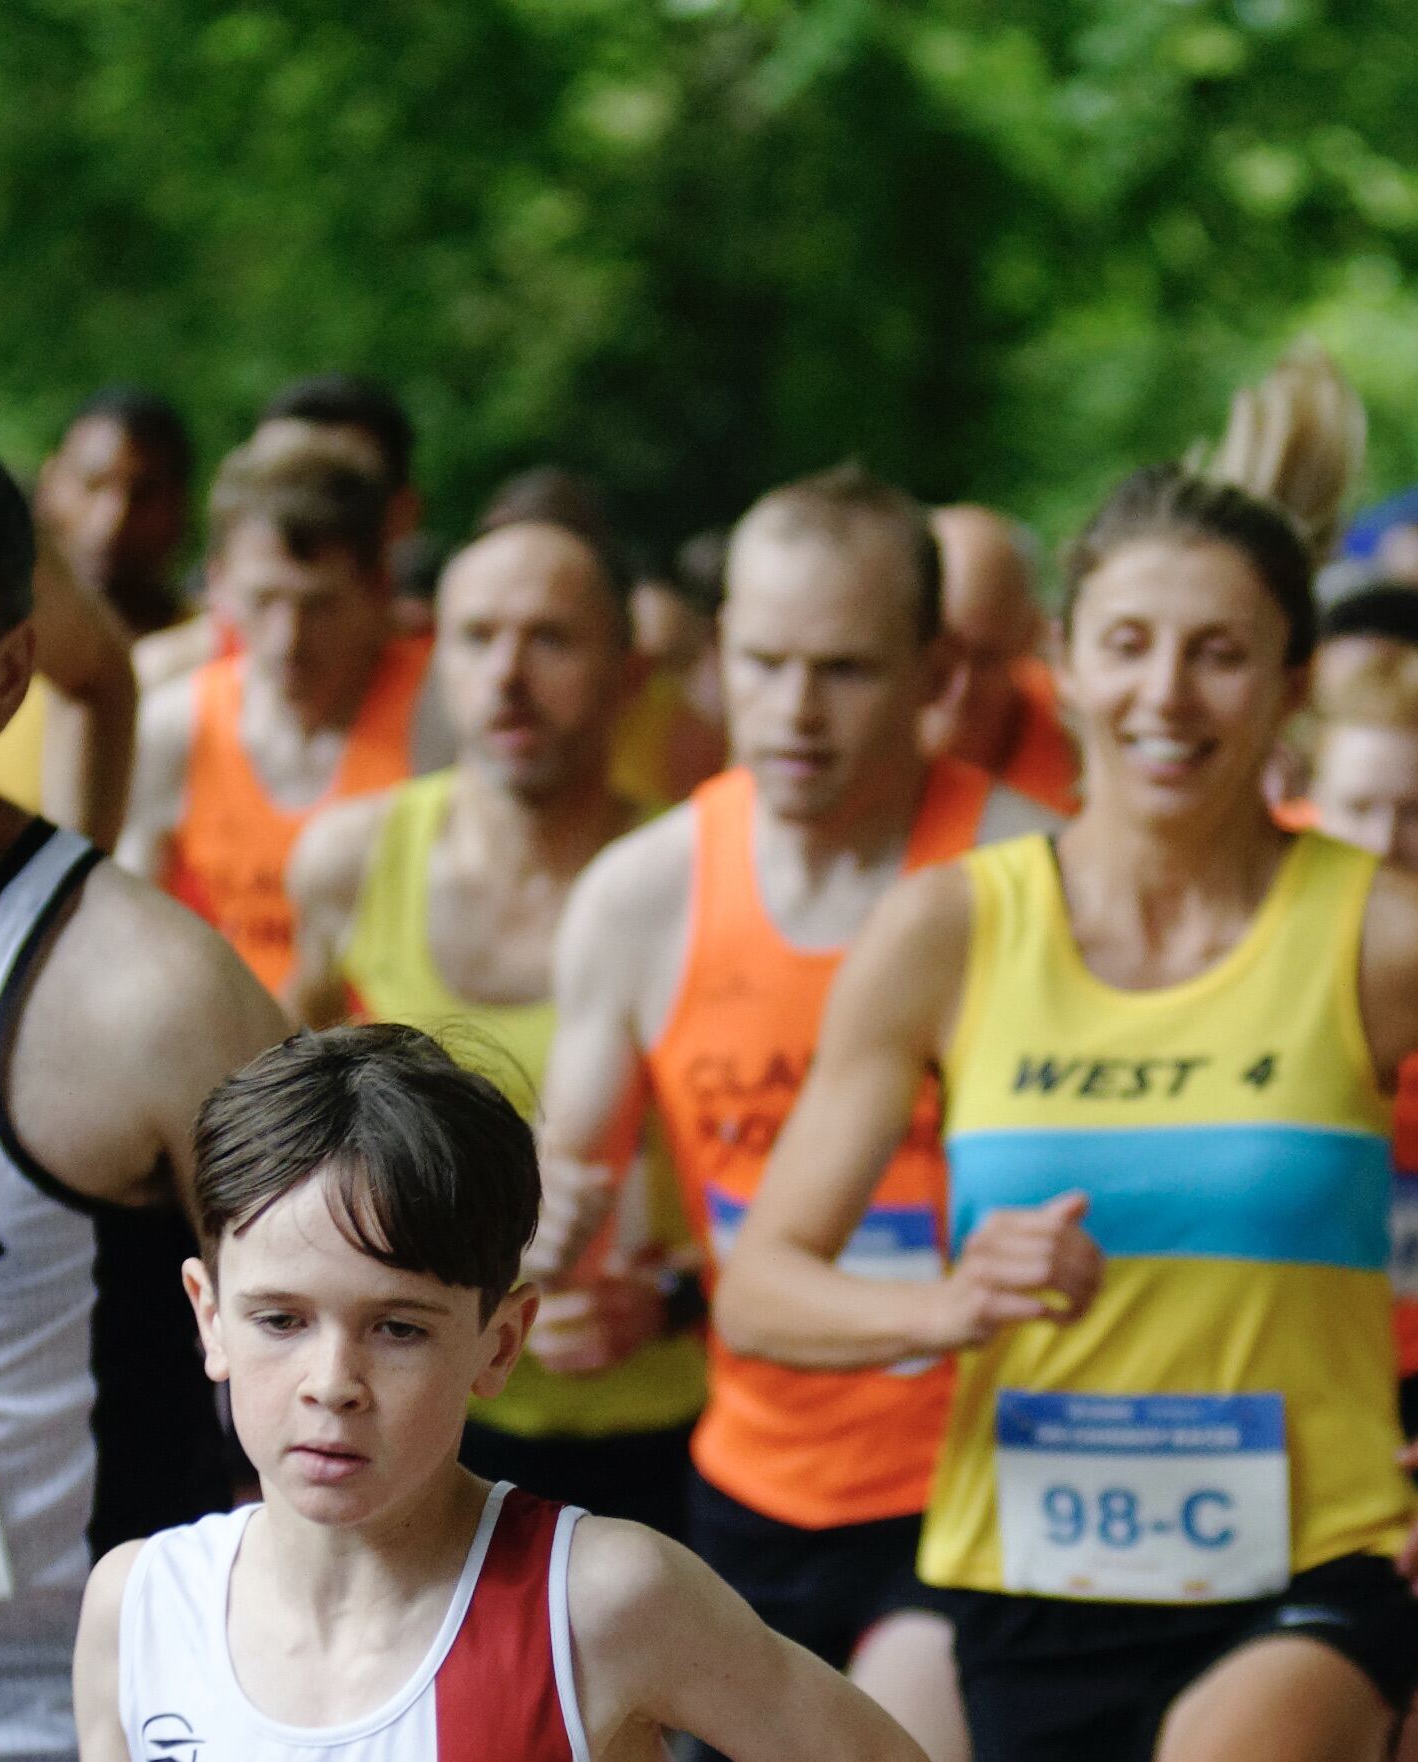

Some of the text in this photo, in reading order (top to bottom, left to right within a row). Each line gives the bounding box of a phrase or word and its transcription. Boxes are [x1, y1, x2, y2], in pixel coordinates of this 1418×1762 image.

[1011, 1051, 1276, 1098] WEST 4
[1042, 1485, 1235, 1548] 98-C
